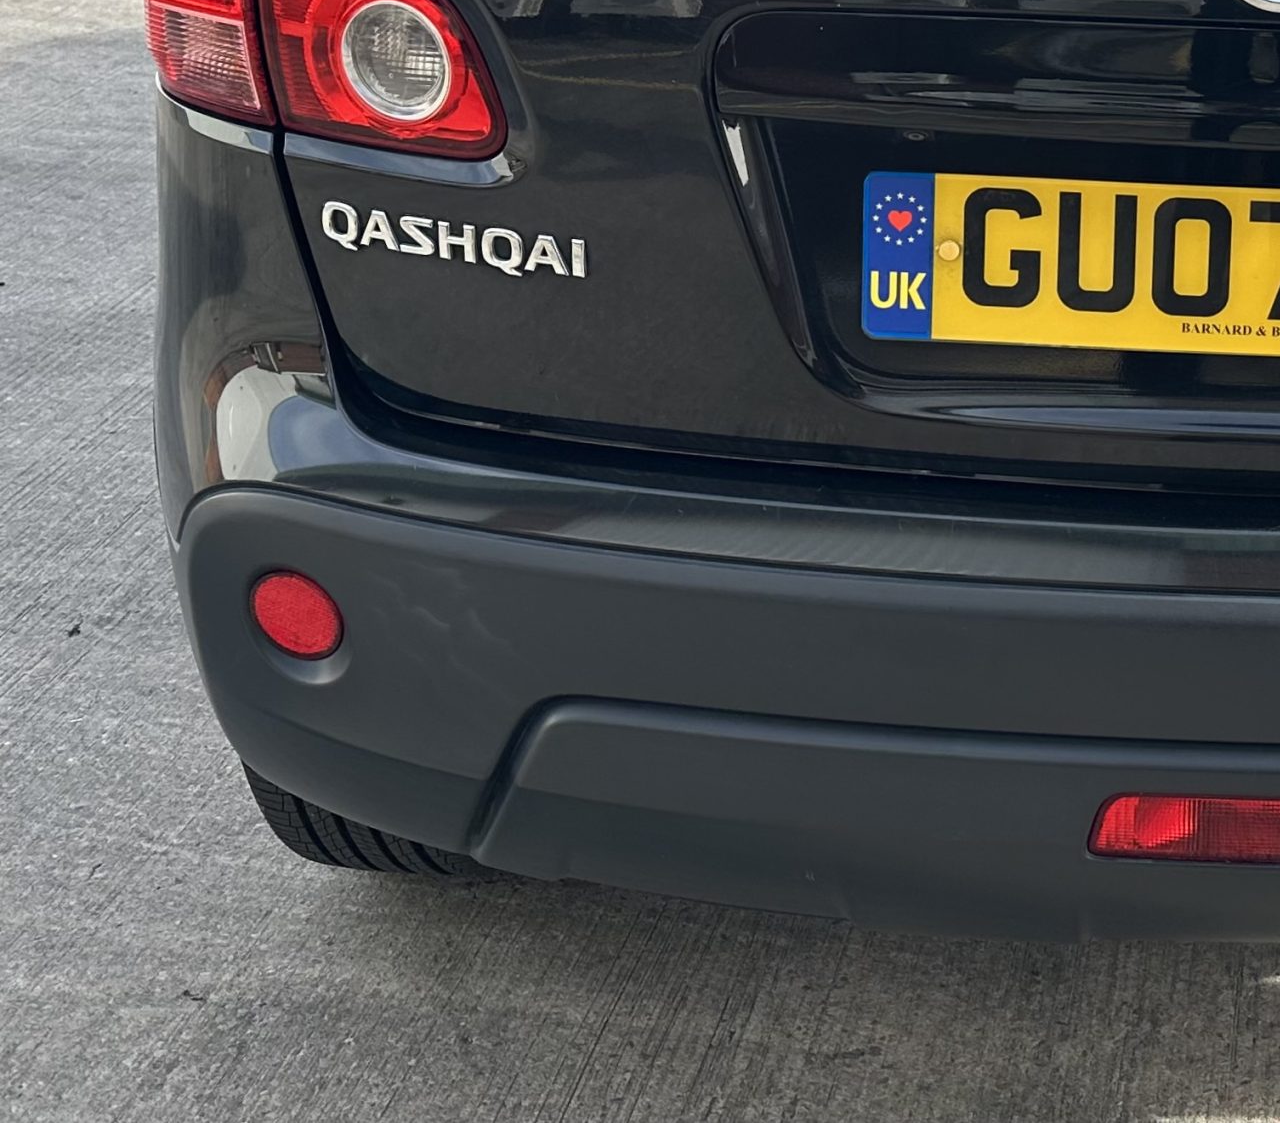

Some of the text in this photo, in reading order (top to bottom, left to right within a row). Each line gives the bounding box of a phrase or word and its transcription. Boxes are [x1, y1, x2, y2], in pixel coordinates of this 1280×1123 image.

[321, 200, 586, 278] QASHQAI
[869, 269, 927, 310] UK
[1181, 322, 1252, 336] BARNARD
[1255, 325, 1267, 337] &
